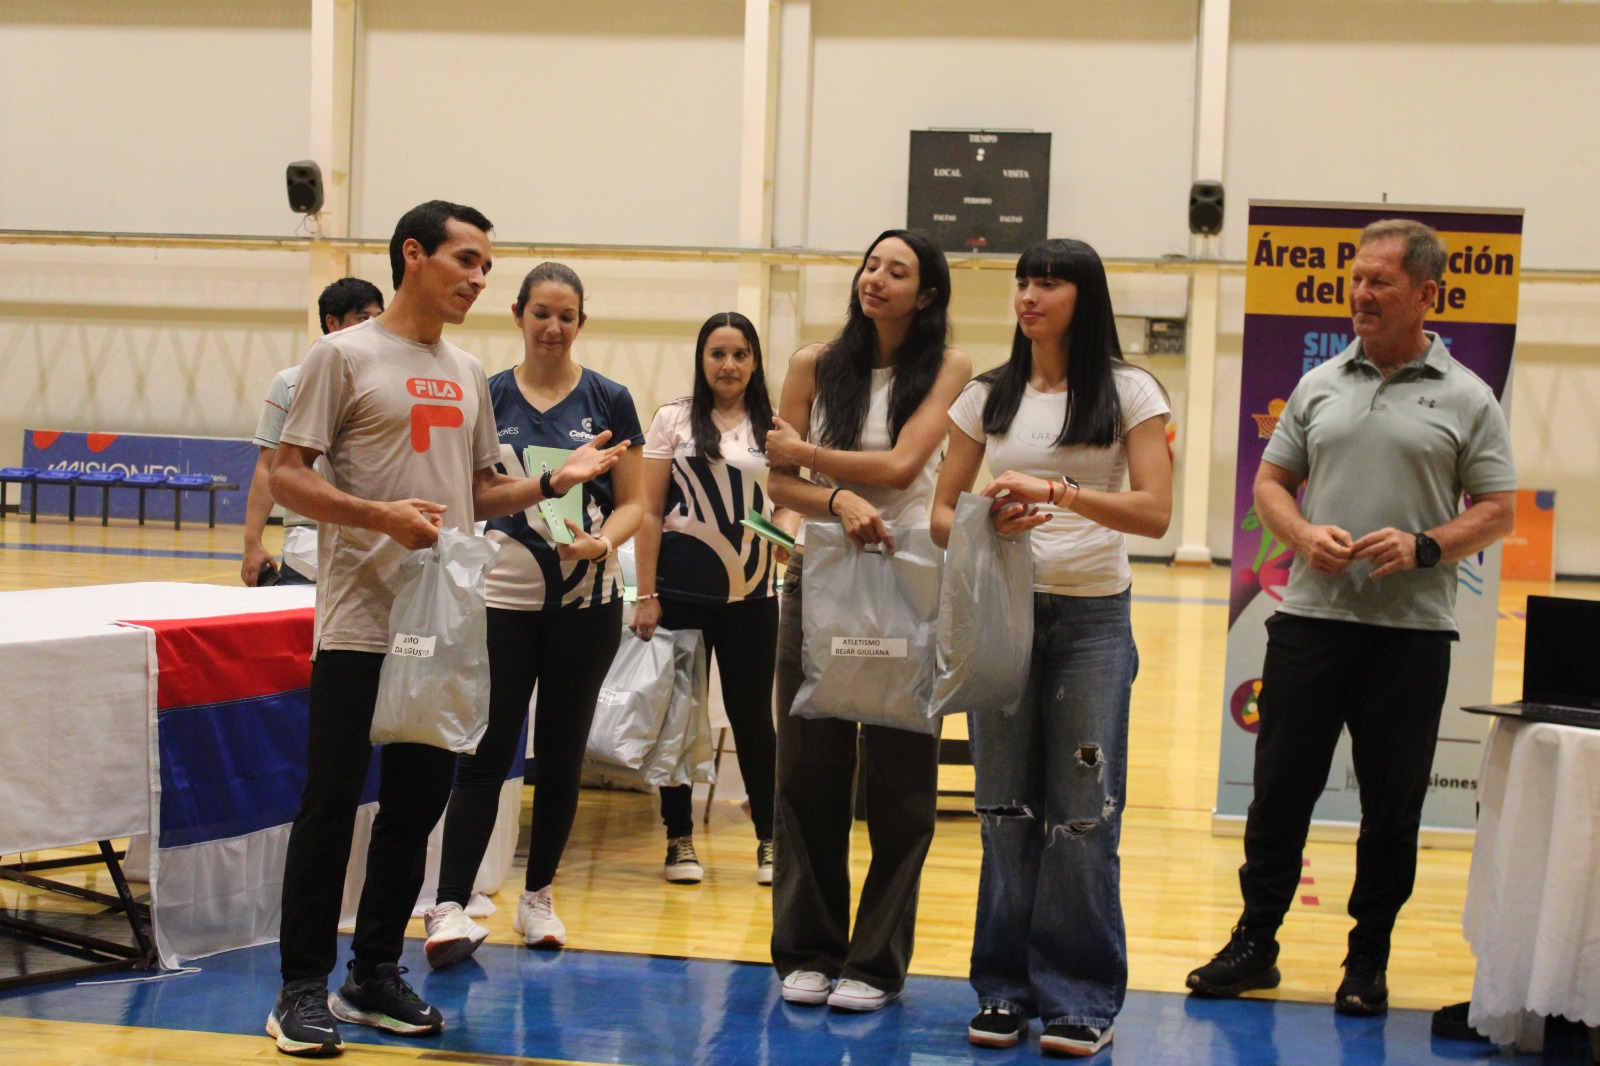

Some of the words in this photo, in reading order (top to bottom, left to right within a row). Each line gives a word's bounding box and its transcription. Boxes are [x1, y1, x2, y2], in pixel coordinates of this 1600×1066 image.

[933, 168, 962, 177] LOCAL
[1003, 169, 1029, 178] VISITA
[1254, 232, 1326, 269] Área
[1296, 275, 1344, 304] del
[1303, 332, 1348, 356] SIN
[414, 380, 457, 399] FILA
[857, 648, 890, 656] GIULIANA
